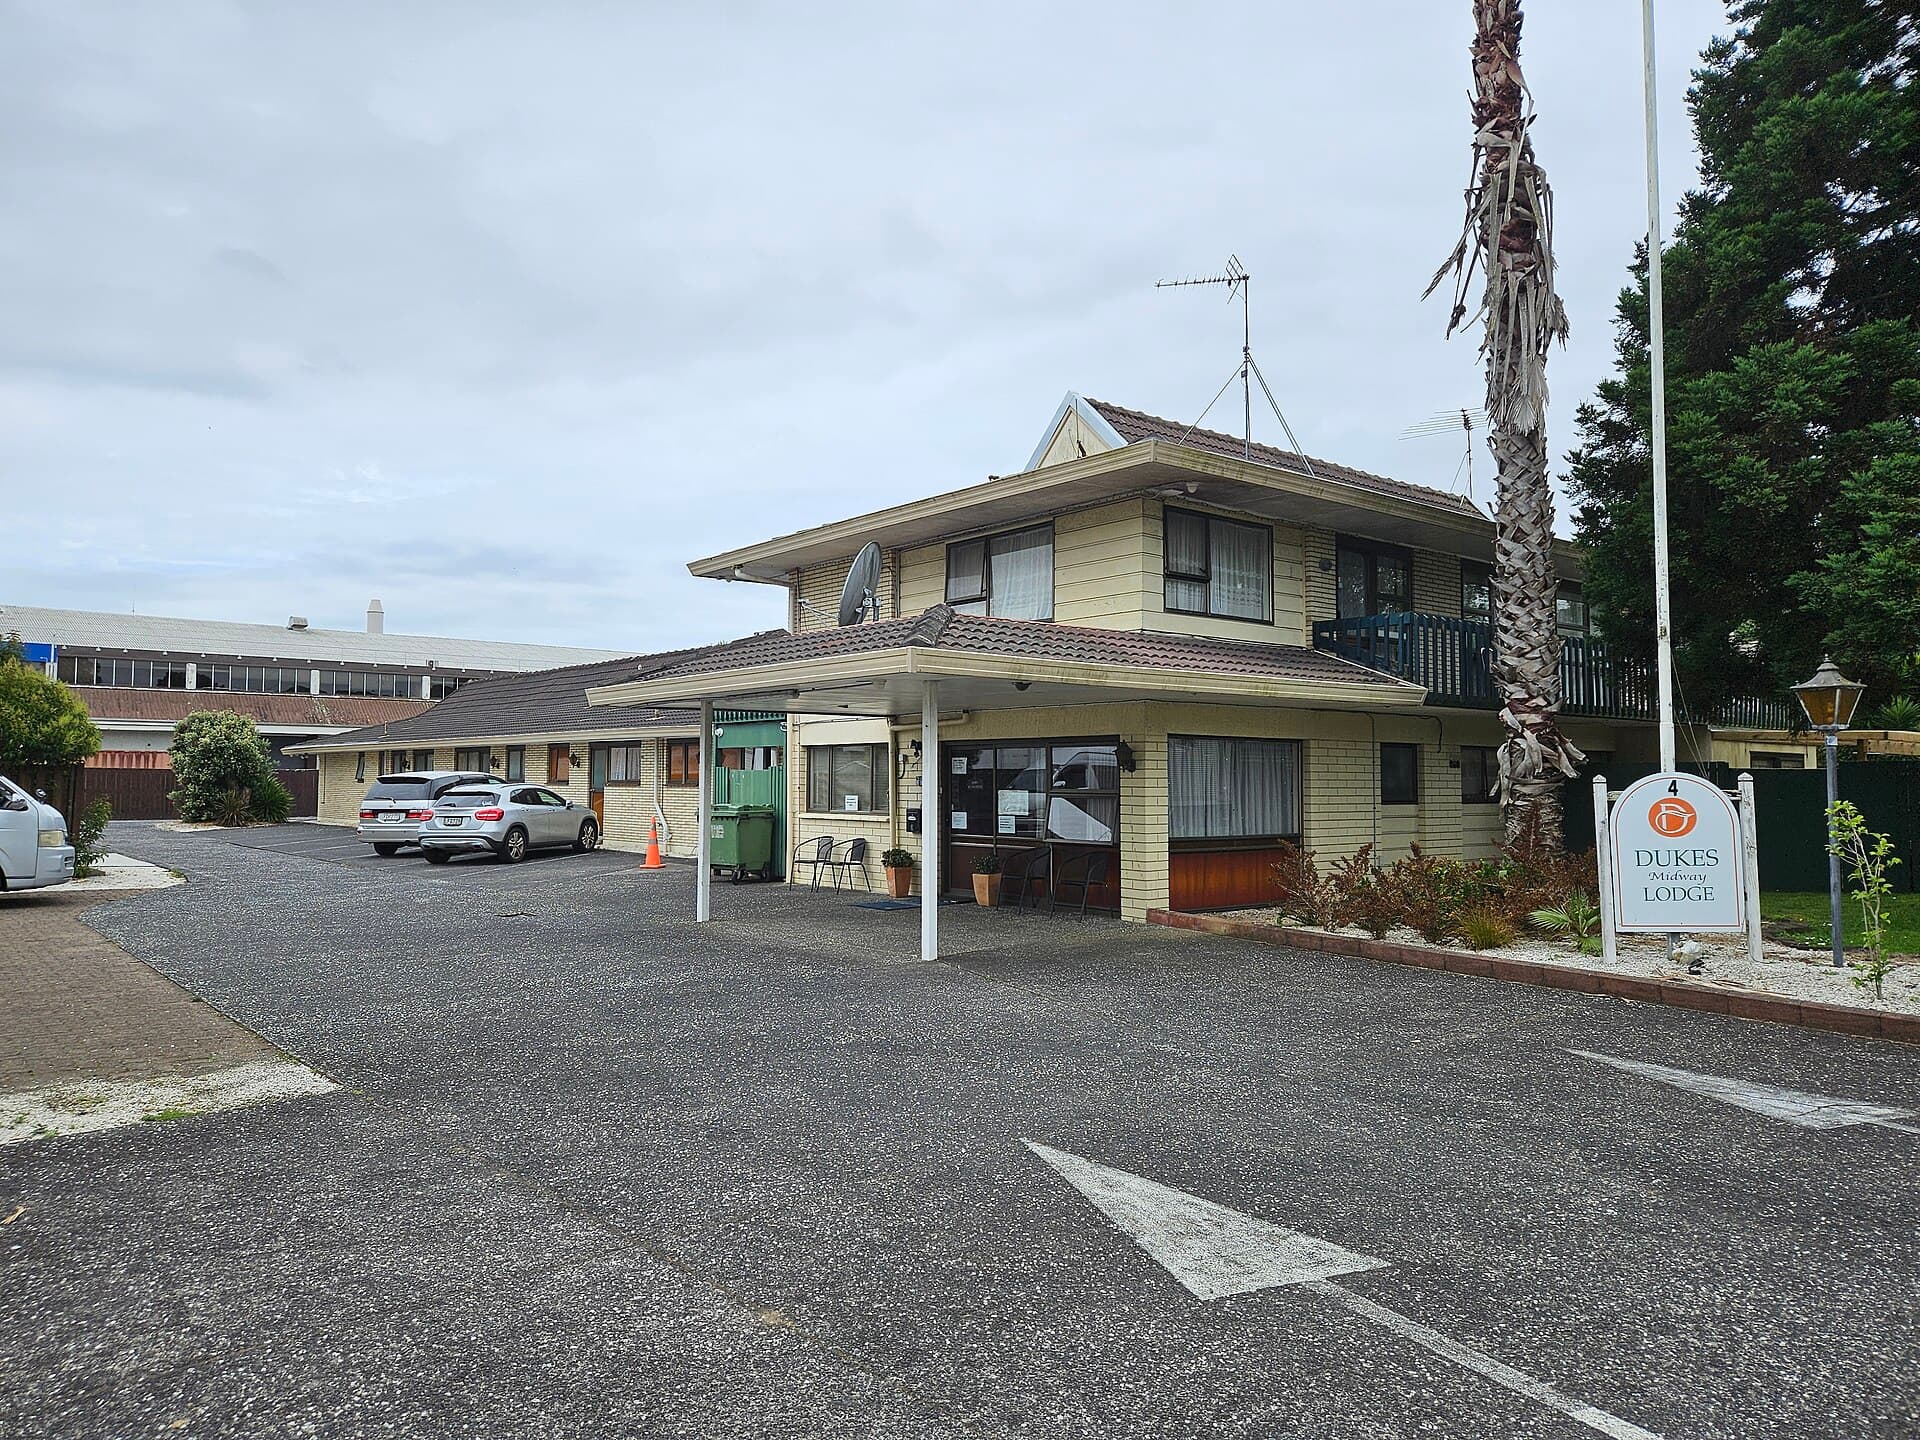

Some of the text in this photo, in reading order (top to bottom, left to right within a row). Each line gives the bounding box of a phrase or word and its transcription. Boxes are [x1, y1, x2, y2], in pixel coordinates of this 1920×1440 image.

[1668, 780, 1679, 796] 4
[1635, 849, 1719, 867] DUKES
[1648, 869, 1707, 885] Midway
[1644, 887, 1715, 902] LODGE
